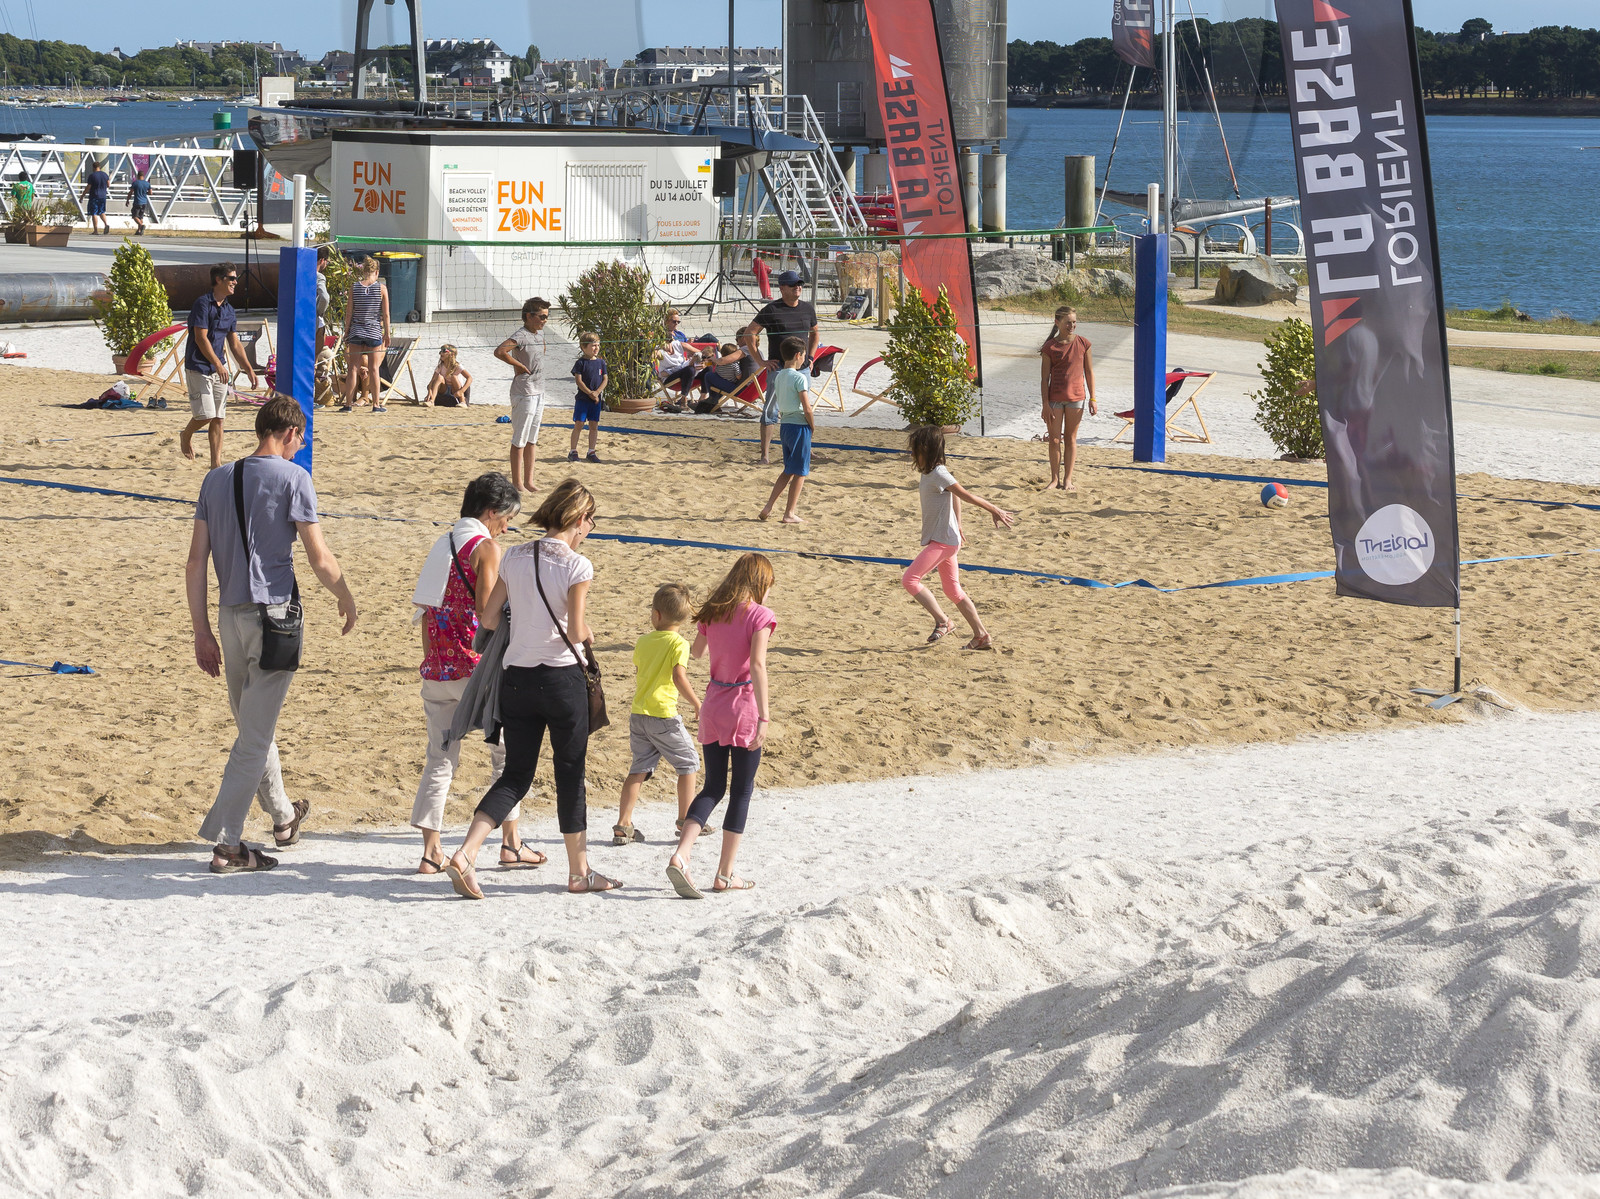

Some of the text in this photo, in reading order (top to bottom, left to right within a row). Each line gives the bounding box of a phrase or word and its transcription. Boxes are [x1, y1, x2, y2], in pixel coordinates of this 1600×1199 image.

[353, 161, 392, 186] FUN
[650, 180, 707, 189] DU 15 JUILLET
[352, 188, 406, 215] ZONE
[498, 181, 544, 205] FUN
[655, 190, 702, 201] AU 14 AOÛT
[497, 208, 562, 232] ZONE
[666, 273, 700, 284] LA BASE
